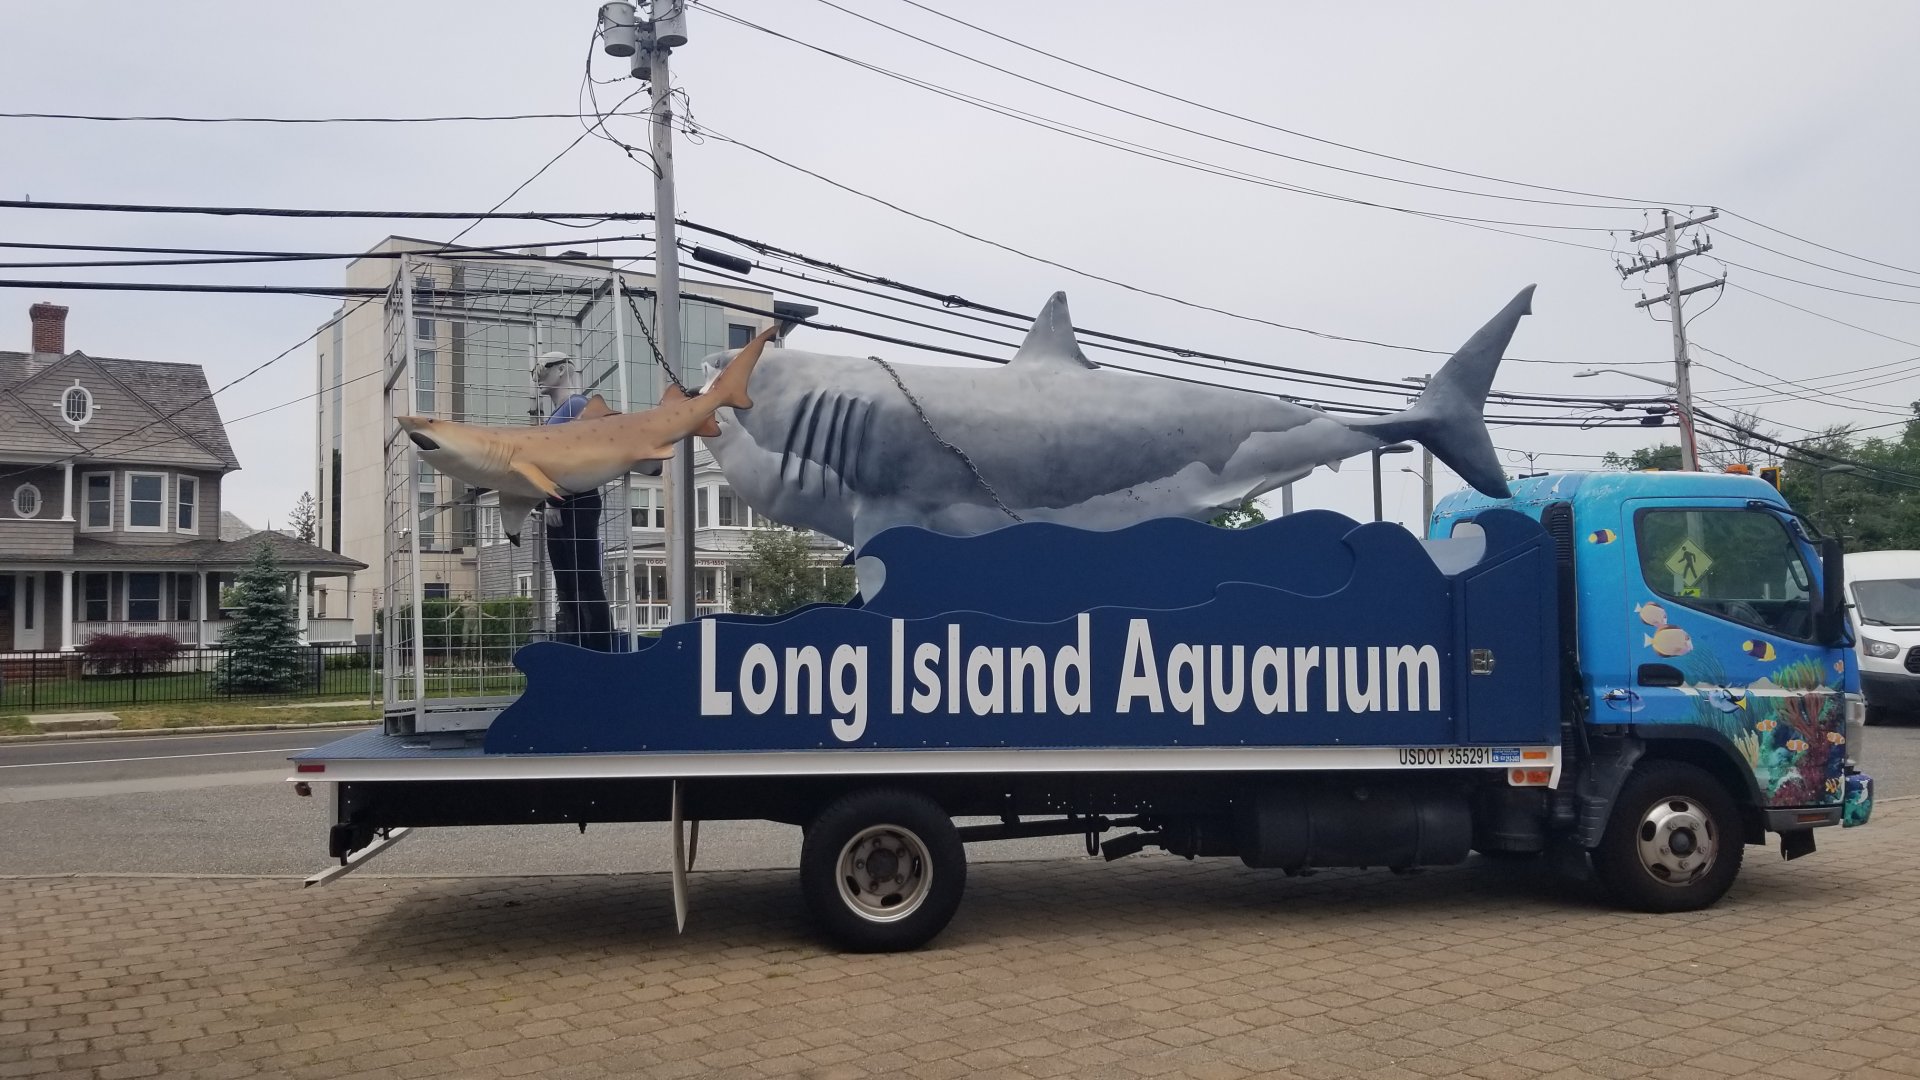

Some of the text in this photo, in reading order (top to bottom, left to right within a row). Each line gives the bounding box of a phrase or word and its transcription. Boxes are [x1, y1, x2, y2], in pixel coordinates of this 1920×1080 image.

[701, 613, 1441, 742] Long Island Aquarium
[1399, 748, 1445, 765] USDOT
[1448, 747, 1490, 765] 355291
